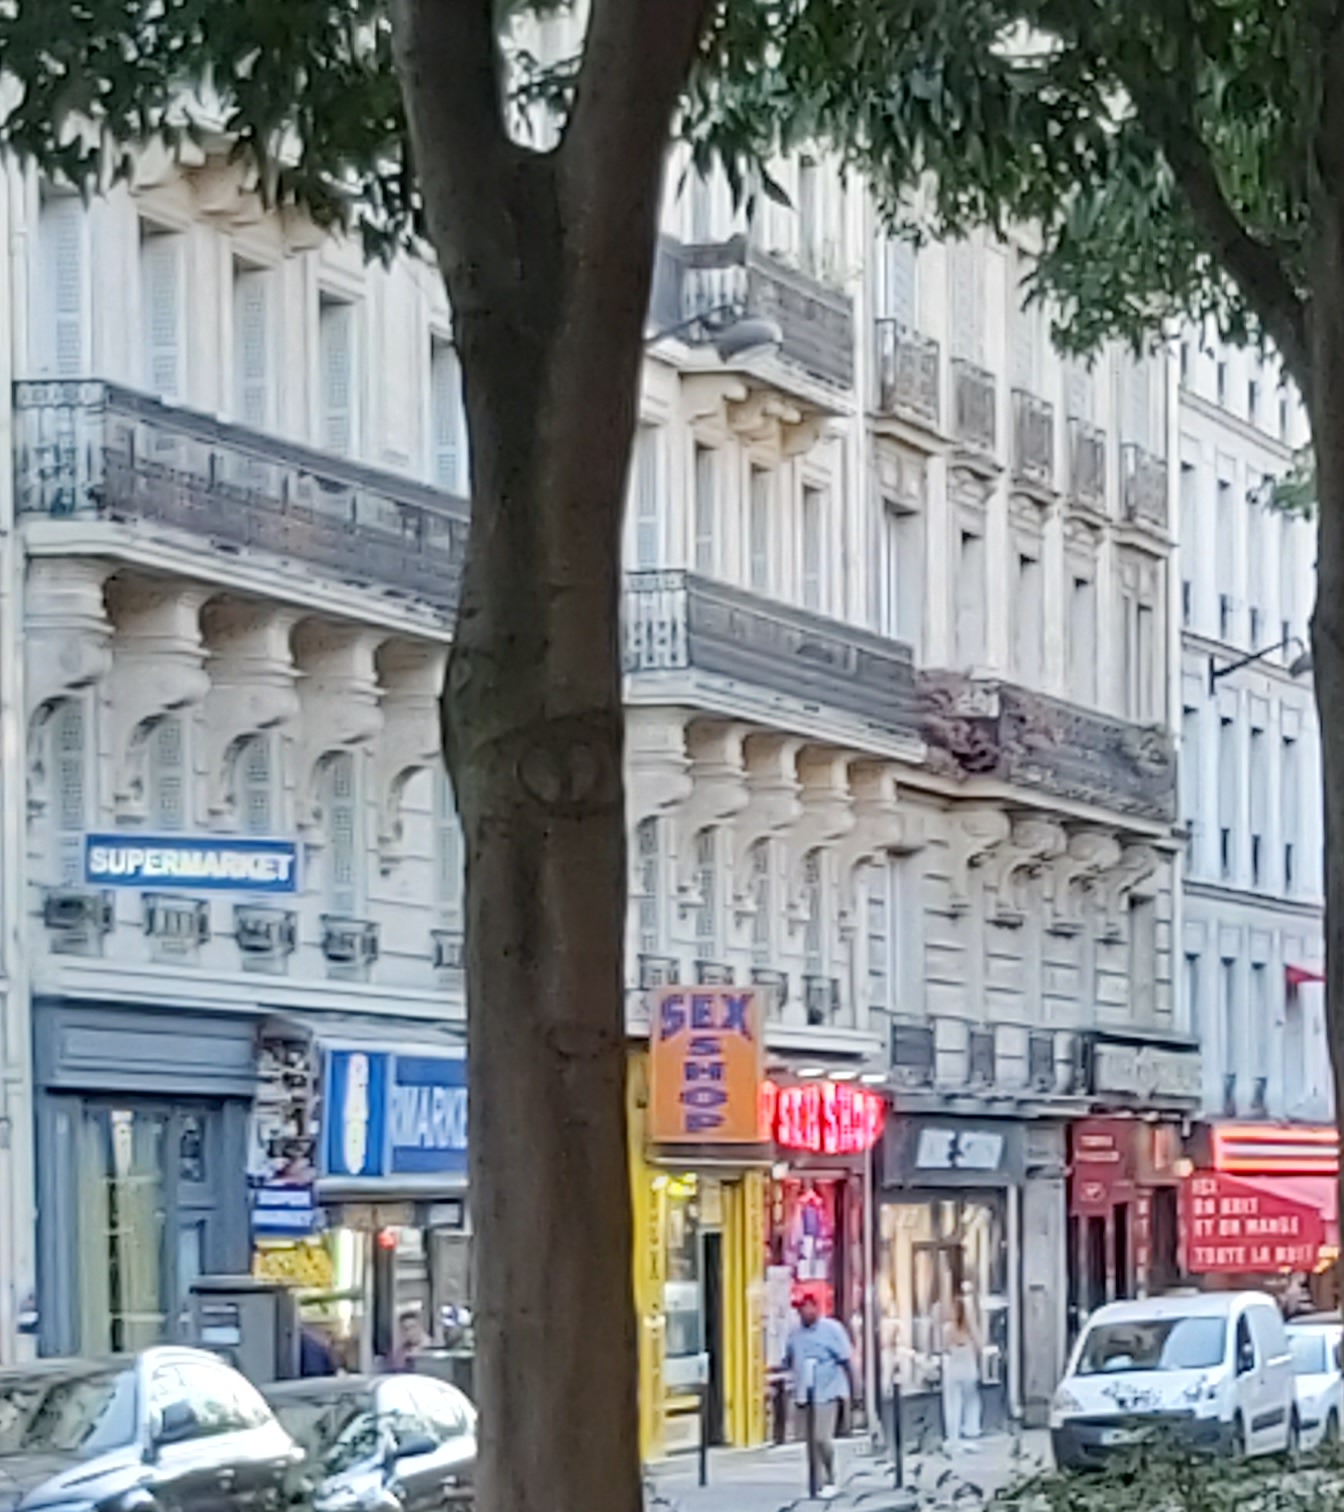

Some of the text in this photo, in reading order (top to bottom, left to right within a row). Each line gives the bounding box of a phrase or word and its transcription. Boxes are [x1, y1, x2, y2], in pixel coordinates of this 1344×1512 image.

[89, 847, 294, 882] SUPERMARKET
[660, 993, 754, 1042] SEX
[679, 1037, 729, 1133] SHOP
